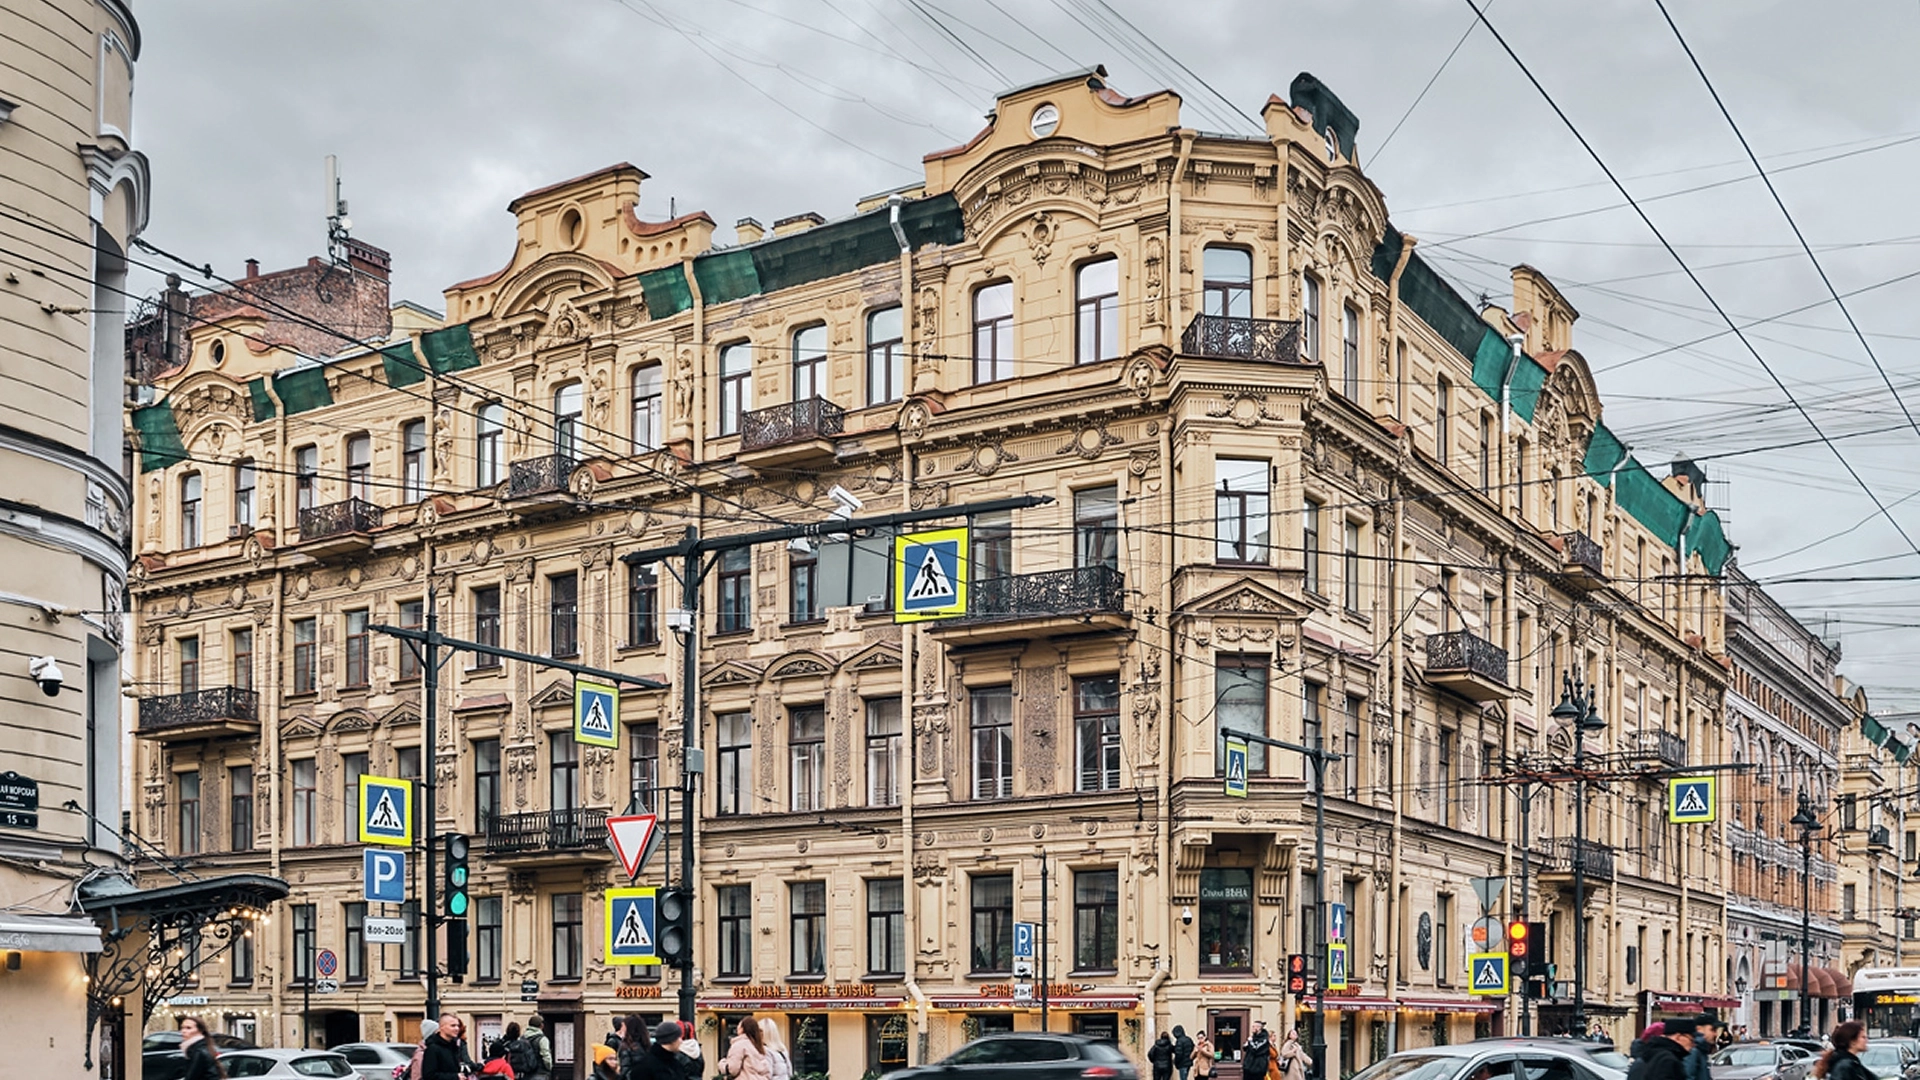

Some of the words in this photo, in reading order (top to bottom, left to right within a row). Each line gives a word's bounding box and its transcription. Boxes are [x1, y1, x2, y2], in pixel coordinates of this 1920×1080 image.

[7, 814, 17, 825] 15
[615, 986, 662, 998] РЕСТОРАН
[732, 985, 781, 998] GEORGIAN
[798, 984, 830, 998] UZBEK
[835, 984, 876, 997] CUISINE
